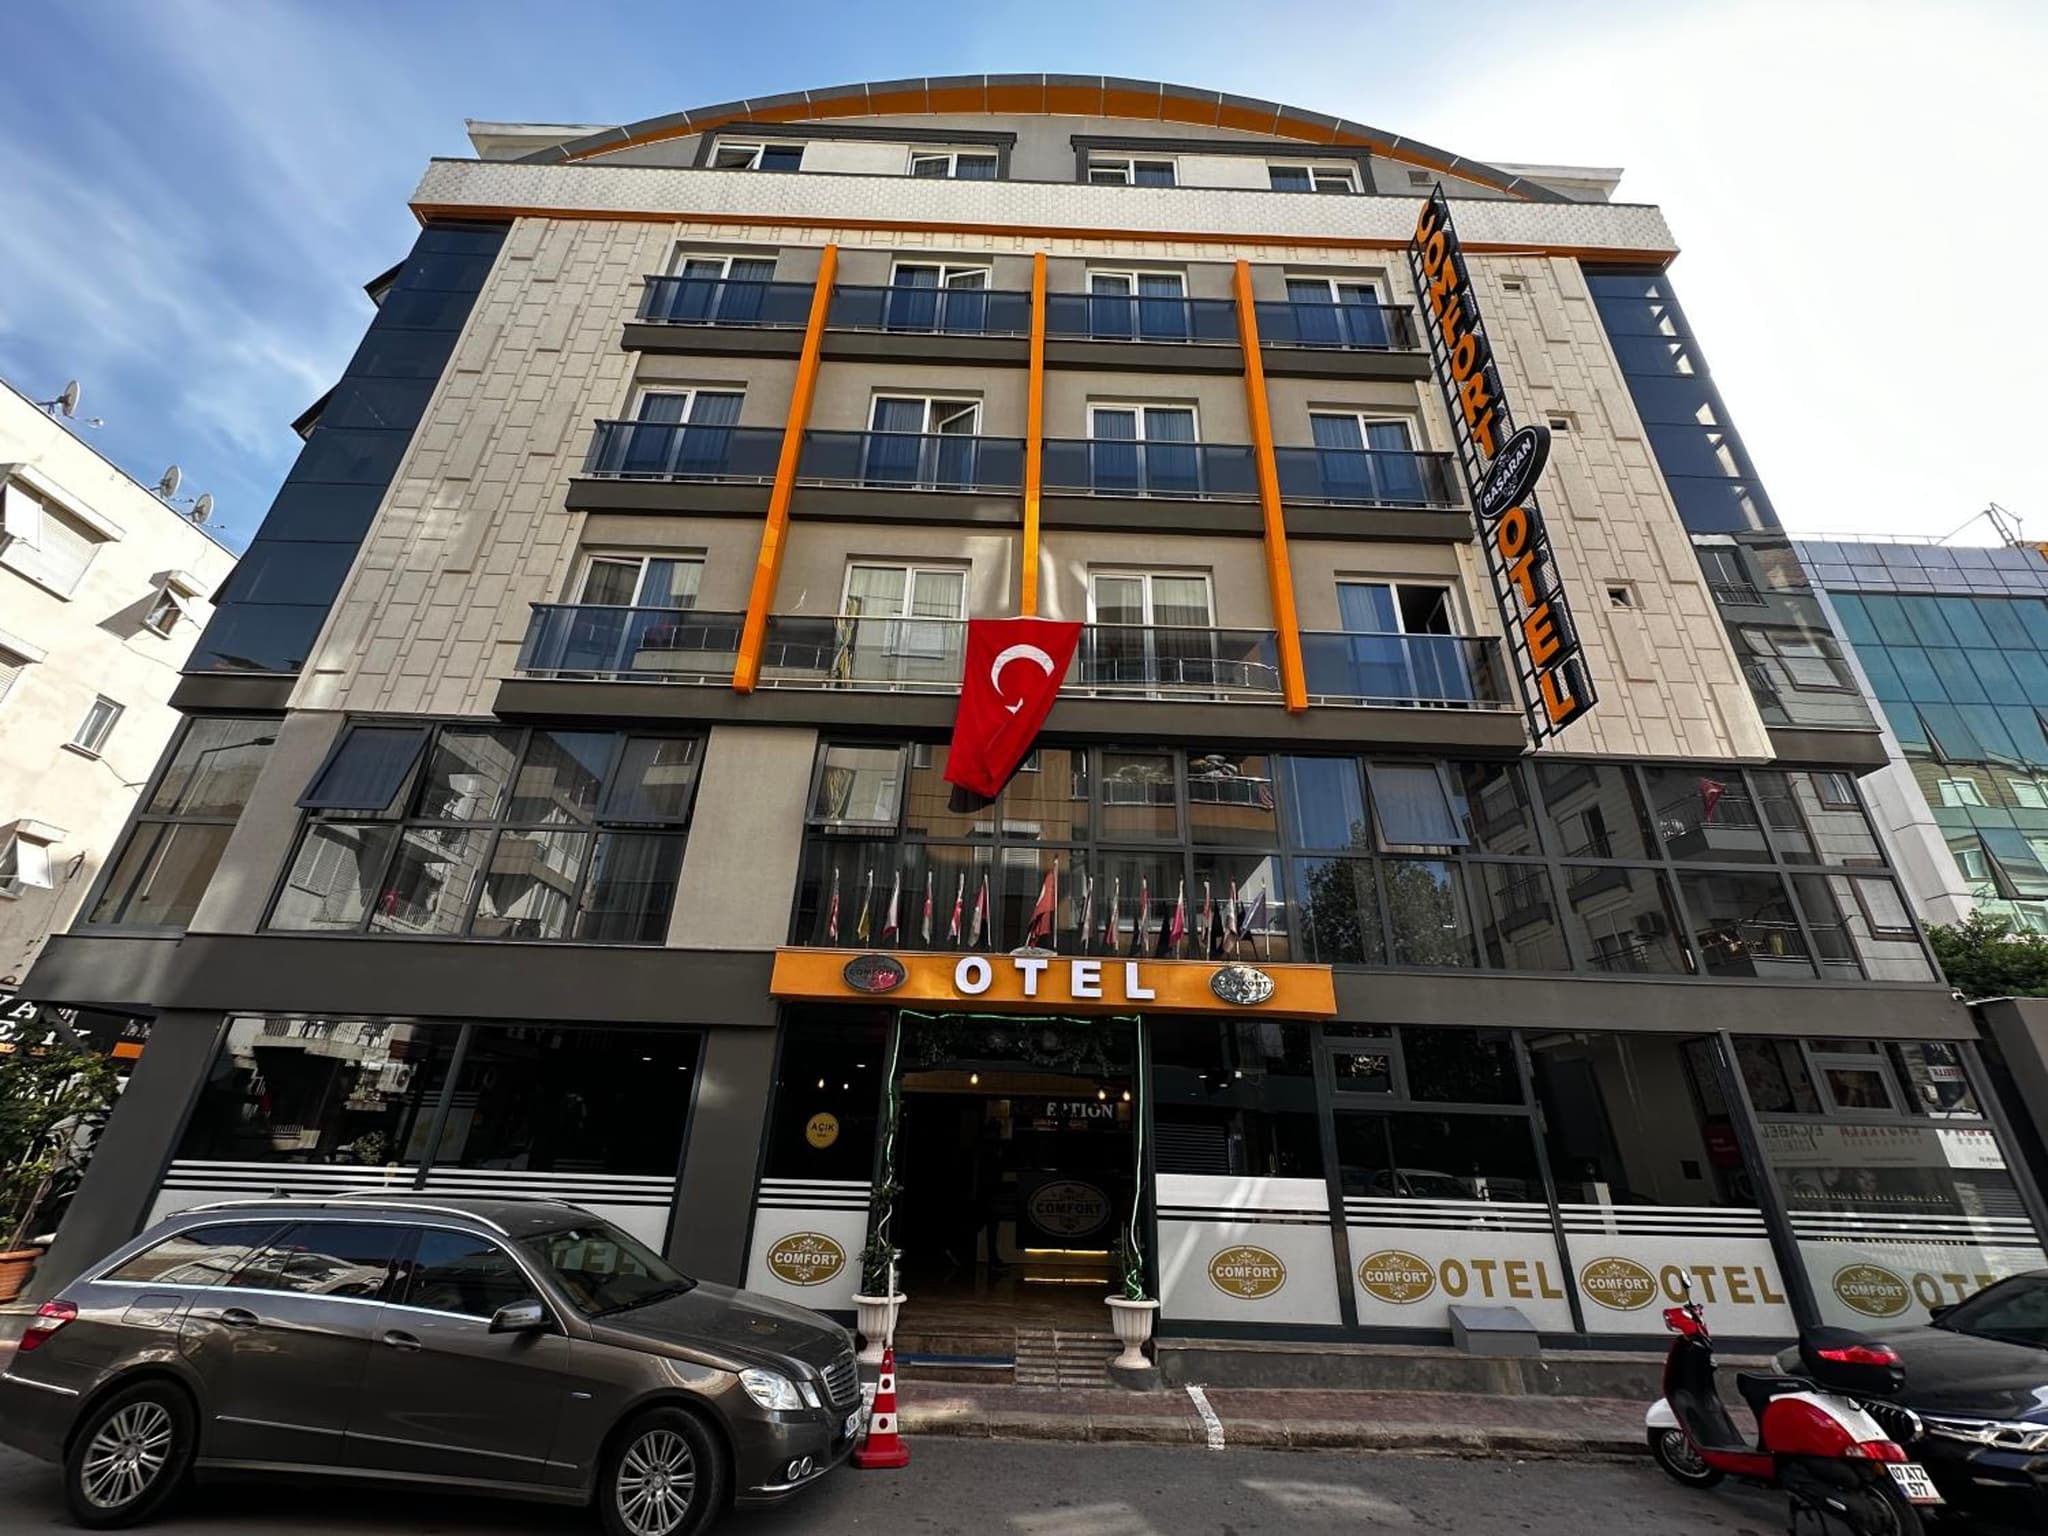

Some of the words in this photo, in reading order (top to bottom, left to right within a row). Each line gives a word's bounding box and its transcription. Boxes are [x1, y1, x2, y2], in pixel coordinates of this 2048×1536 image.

[1417, 200, 1494, 460] COMFORT
[1498, 506, 1576, 724] OTEL
[954, 956, 1156, 1000] OTEL
[1035, 1202, 1102, 1216] COMFORT
[774, 1252, 838, 1266] COMFORT
[1215, 1266, 1279, 1278] COMFORT
[1365, 1270, 1428, 1284] COMFORT
[1439, 1258, 1564, 1300] OTEL
[1587, 1277, 1650, 1291] COMFORT
[1659, 1264, 1786, 1305] OTEL
[1839, 1283, 1903, 1299] COMFORT
[1890, 1466, 1905, 1481] 07
[1907, 1482, 1929, 1496] 577
